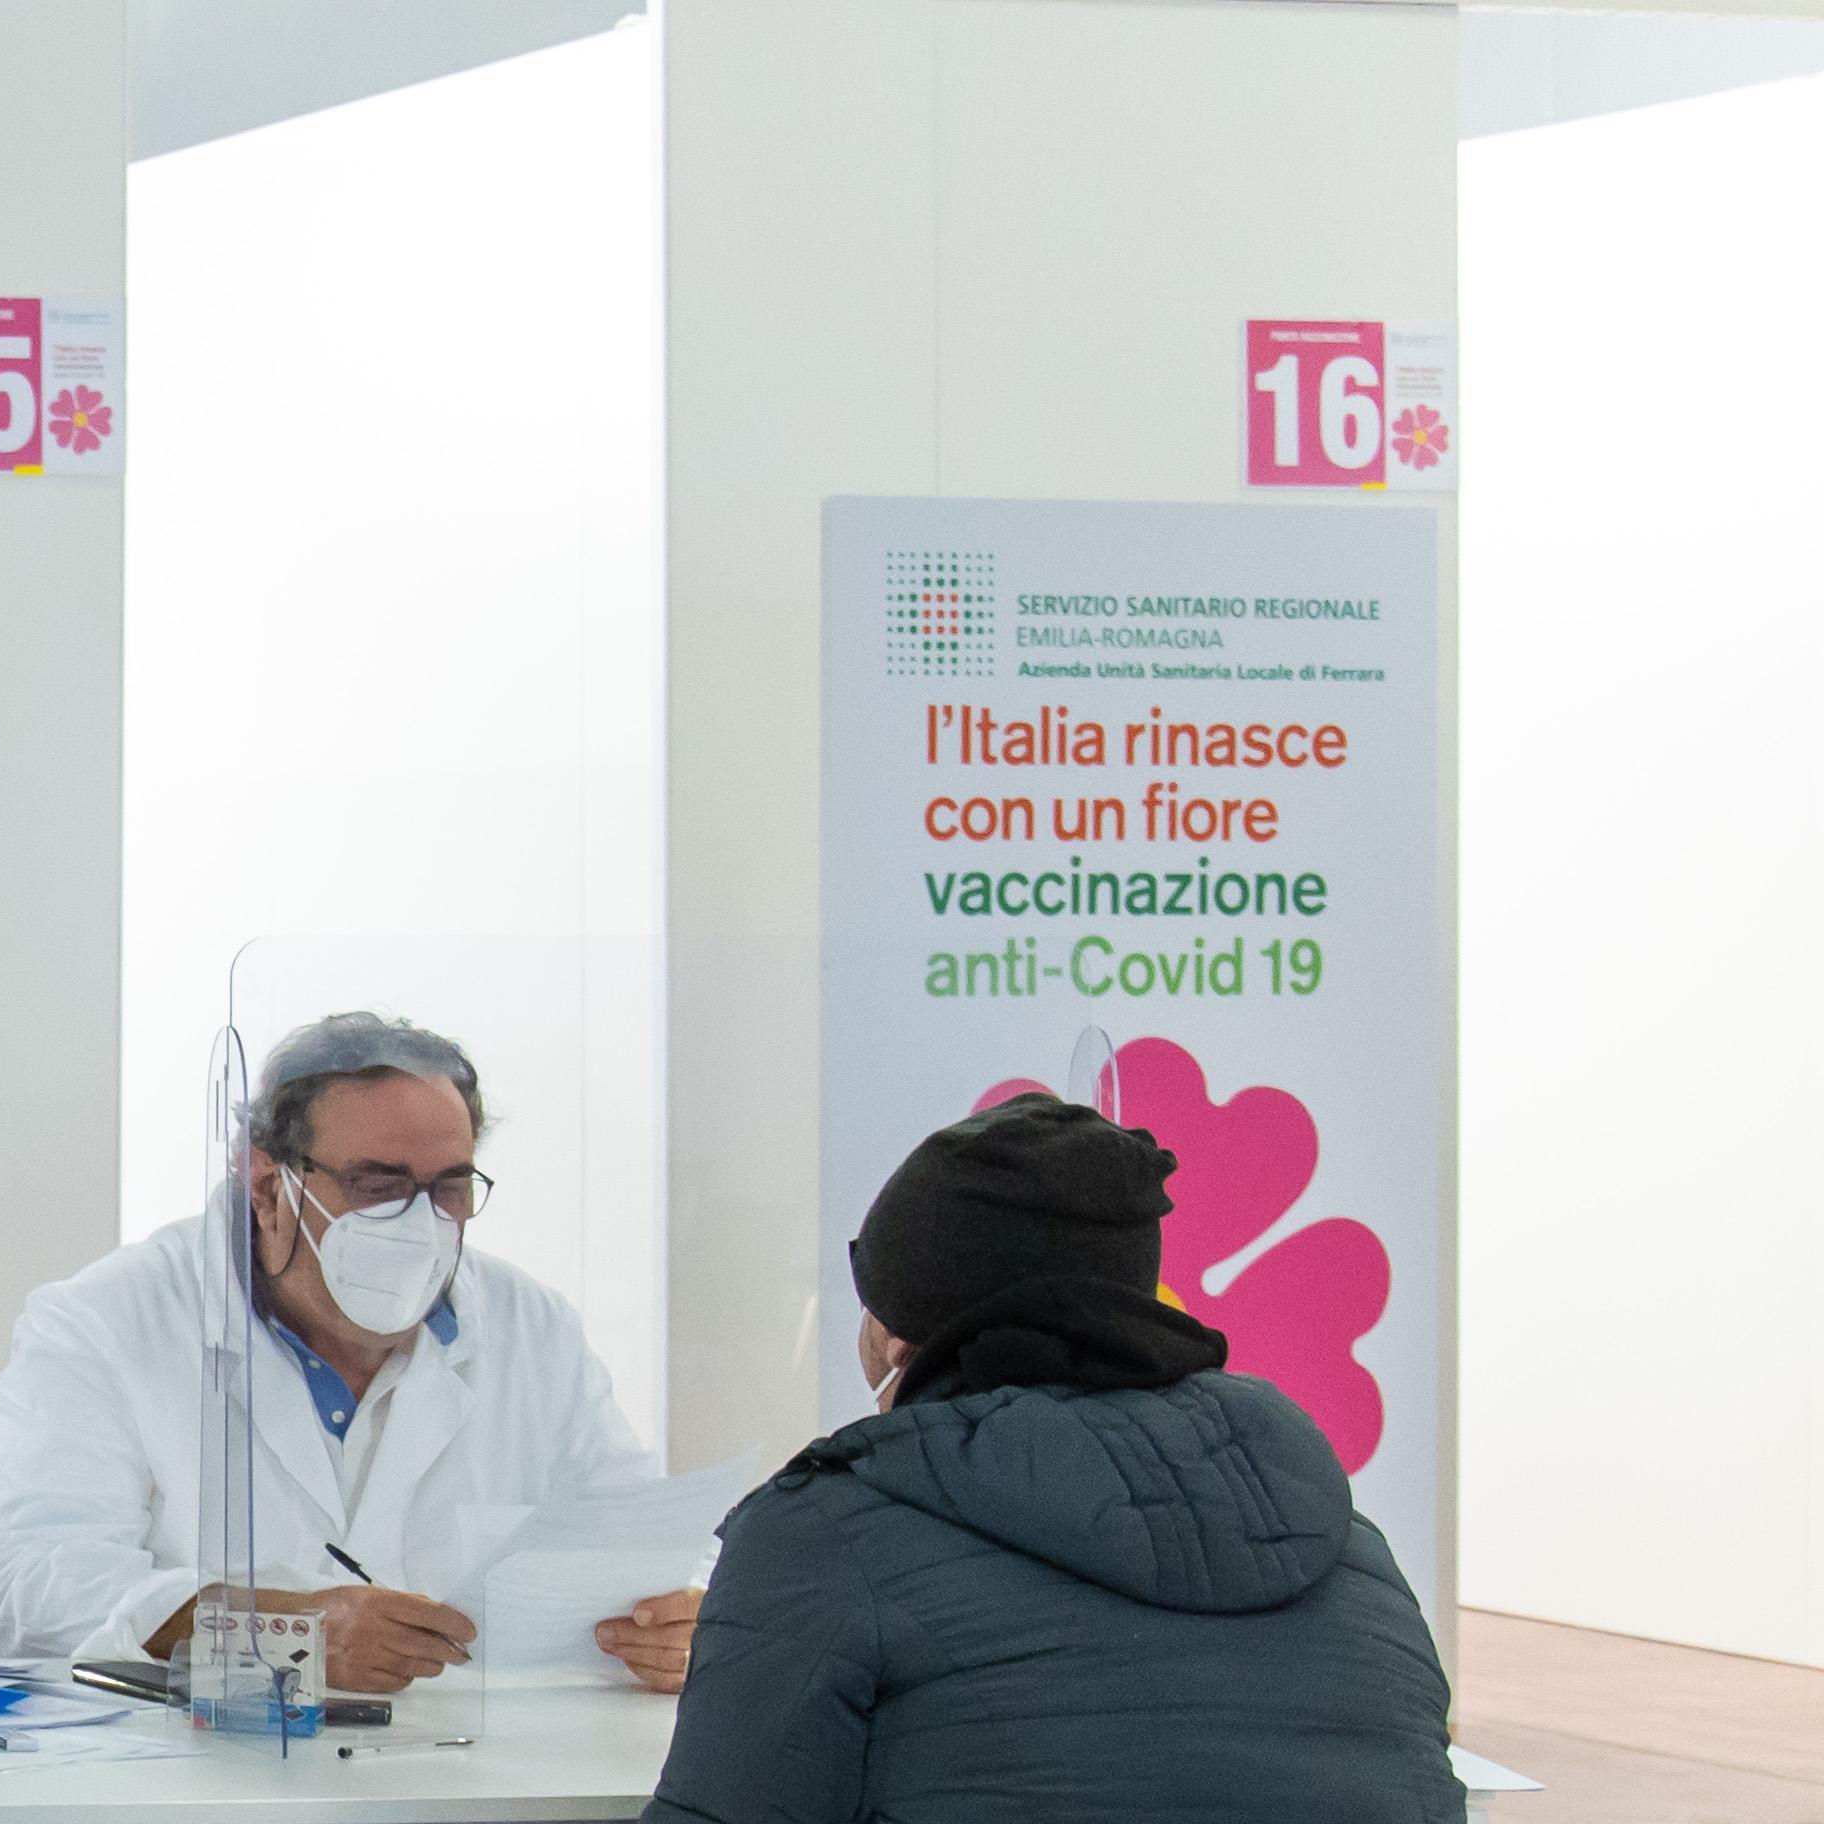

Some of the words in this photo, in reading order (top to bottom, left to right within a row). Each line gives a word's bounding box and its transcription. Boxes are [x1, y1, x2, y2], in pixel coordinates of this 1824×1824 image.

[1256, 355, 1381, 470] 16
[1016, 625, 1224, 650] EMILIA-ROMAGNA
[1017, 594, 1119, 617] SERVIZIO
[1126, 595, 1247, 619] SANITARIO
[1254, 597, 1380, 621] REGIONALE
[1018, 661, 1092, 678] Azienda
[1096, 663, 1146, 679] Unità
[1151, 662, 1233, 680] Sanitaria
[1236, 663, 1295, 681] Locale
[1298, 664, 1317, 681] di
[1320, 664, 1385, 682] Ferrara
[1126, 707, 1347, 768] rinasce
[925, 797, 1034, 841] con
[1054, 798, 1125, 841] un
[1142, 782, 1278, 842] fiore
[925, 856, 1326, 916] vaccinazione
[926, 936, 1243, 997] anti-Covid
[1261, 939, 1322, 995] 19
